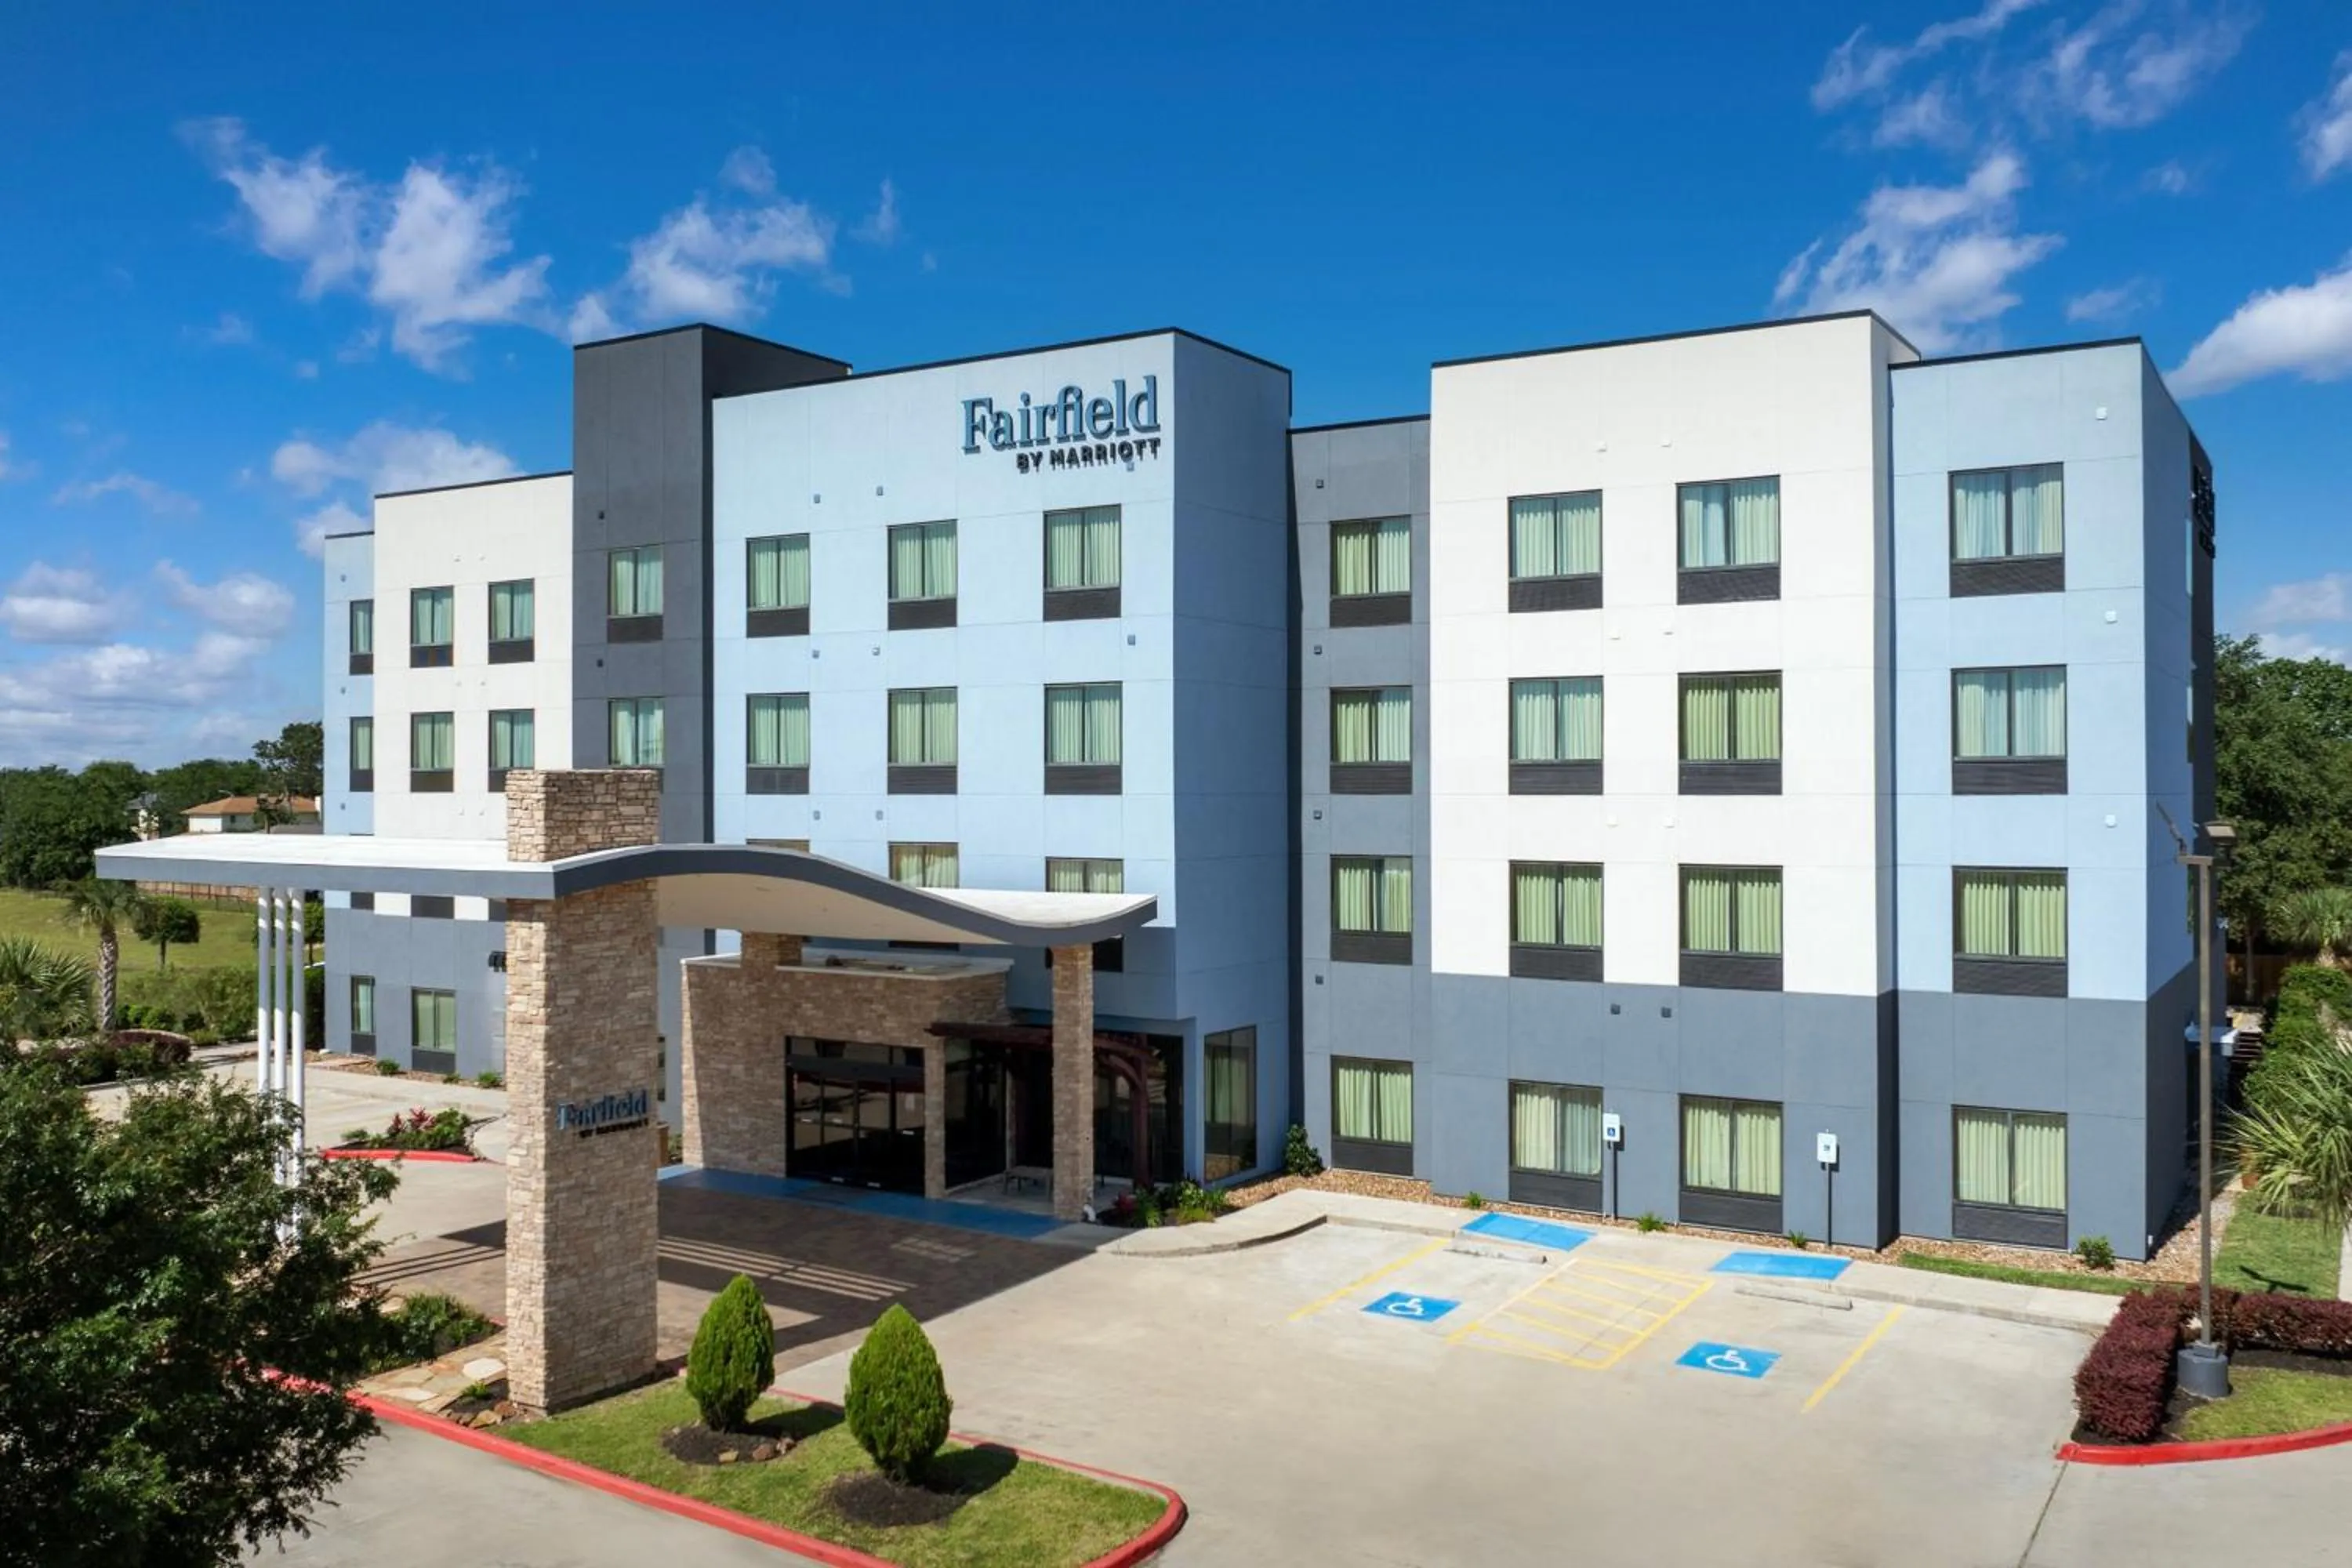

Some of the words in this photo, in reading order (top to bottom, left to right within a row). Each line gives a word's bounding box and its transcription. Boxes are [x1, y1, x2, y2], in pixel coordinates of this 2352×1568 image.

[961, 375, 1161, 455] Fairfield
[1016, 450, 1044, 474] BY
[1049, 437, 1161, 471] MARRIOTT
